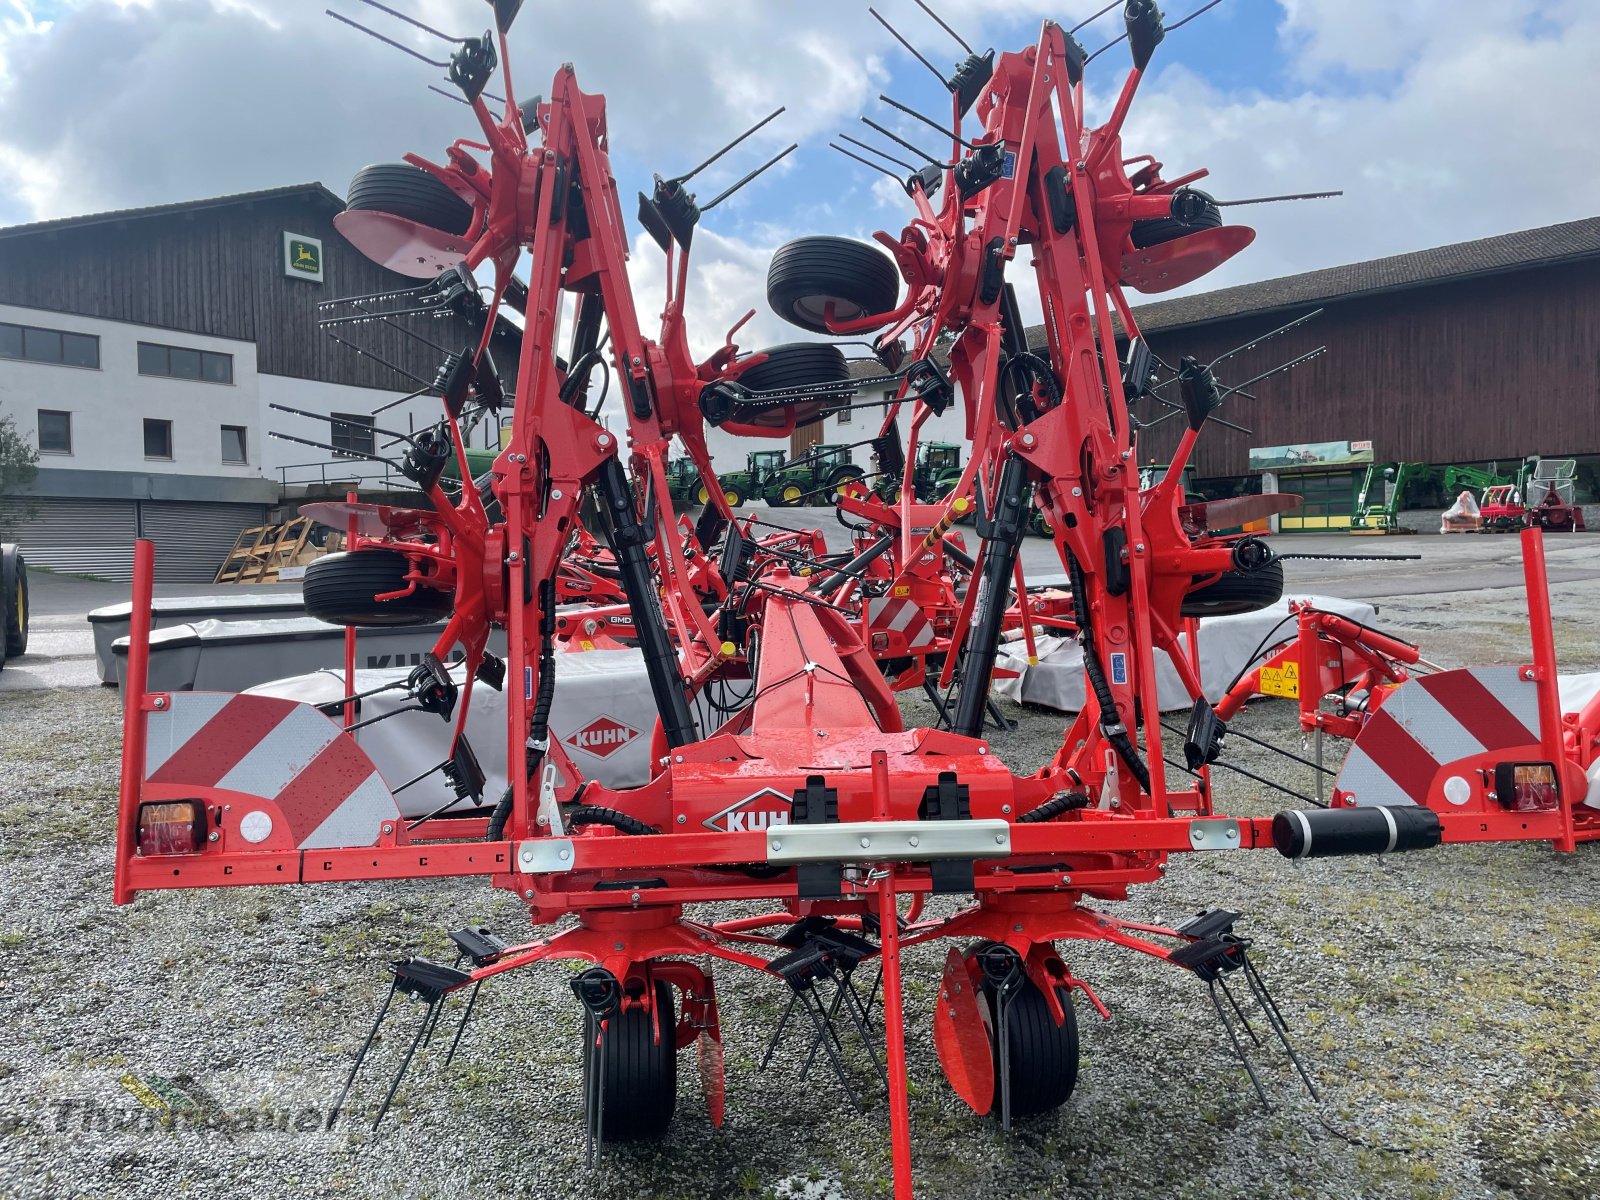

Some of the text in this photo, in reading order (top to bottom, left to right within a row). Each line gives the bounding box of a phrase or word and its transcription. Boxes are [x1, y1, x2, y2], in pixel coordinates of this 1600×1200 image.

[610, 616, 632, 624] GMD
[576, 727, 630, 747] KUHN
[726, 810, 789, 832] KUH
